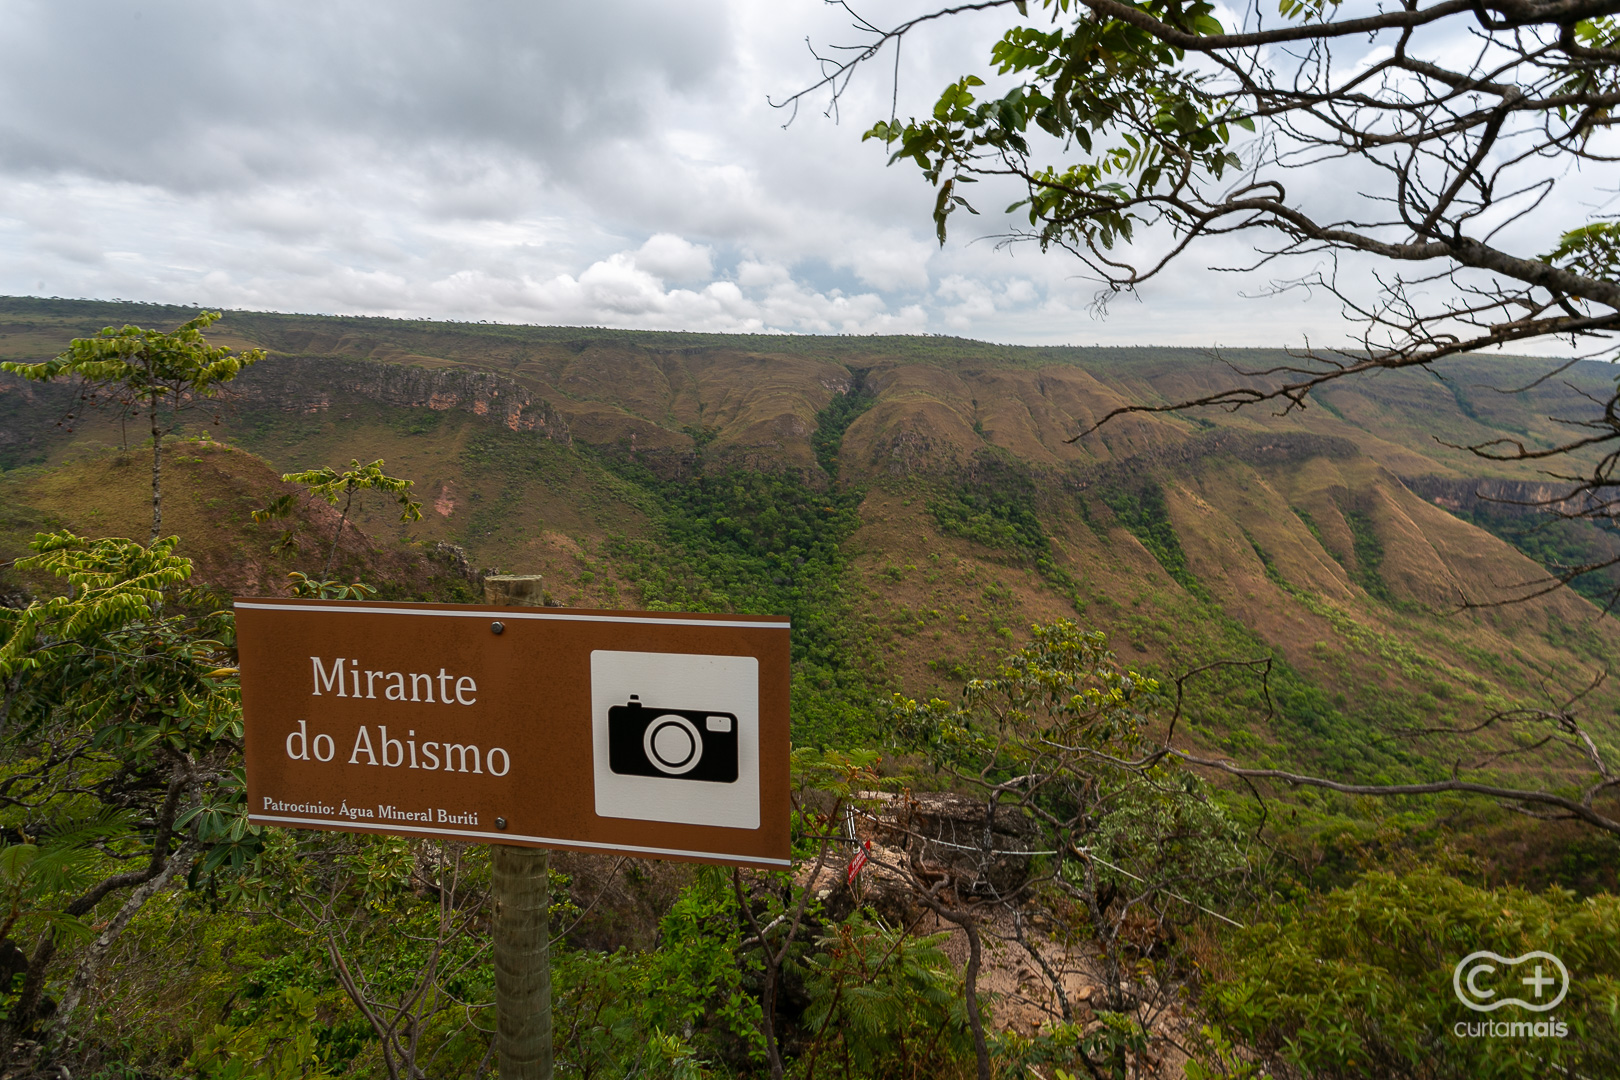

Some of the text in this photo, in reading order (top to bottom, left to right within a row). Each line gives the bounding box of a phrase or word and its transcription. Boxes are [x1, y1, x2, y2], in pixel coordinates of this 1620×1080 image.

[310, 656, 477, 706] Mirante
[286, 720, 510, 777] do Abismo
[263, 796, 479, 826] Patrocínio: Água Mineral Buriti
